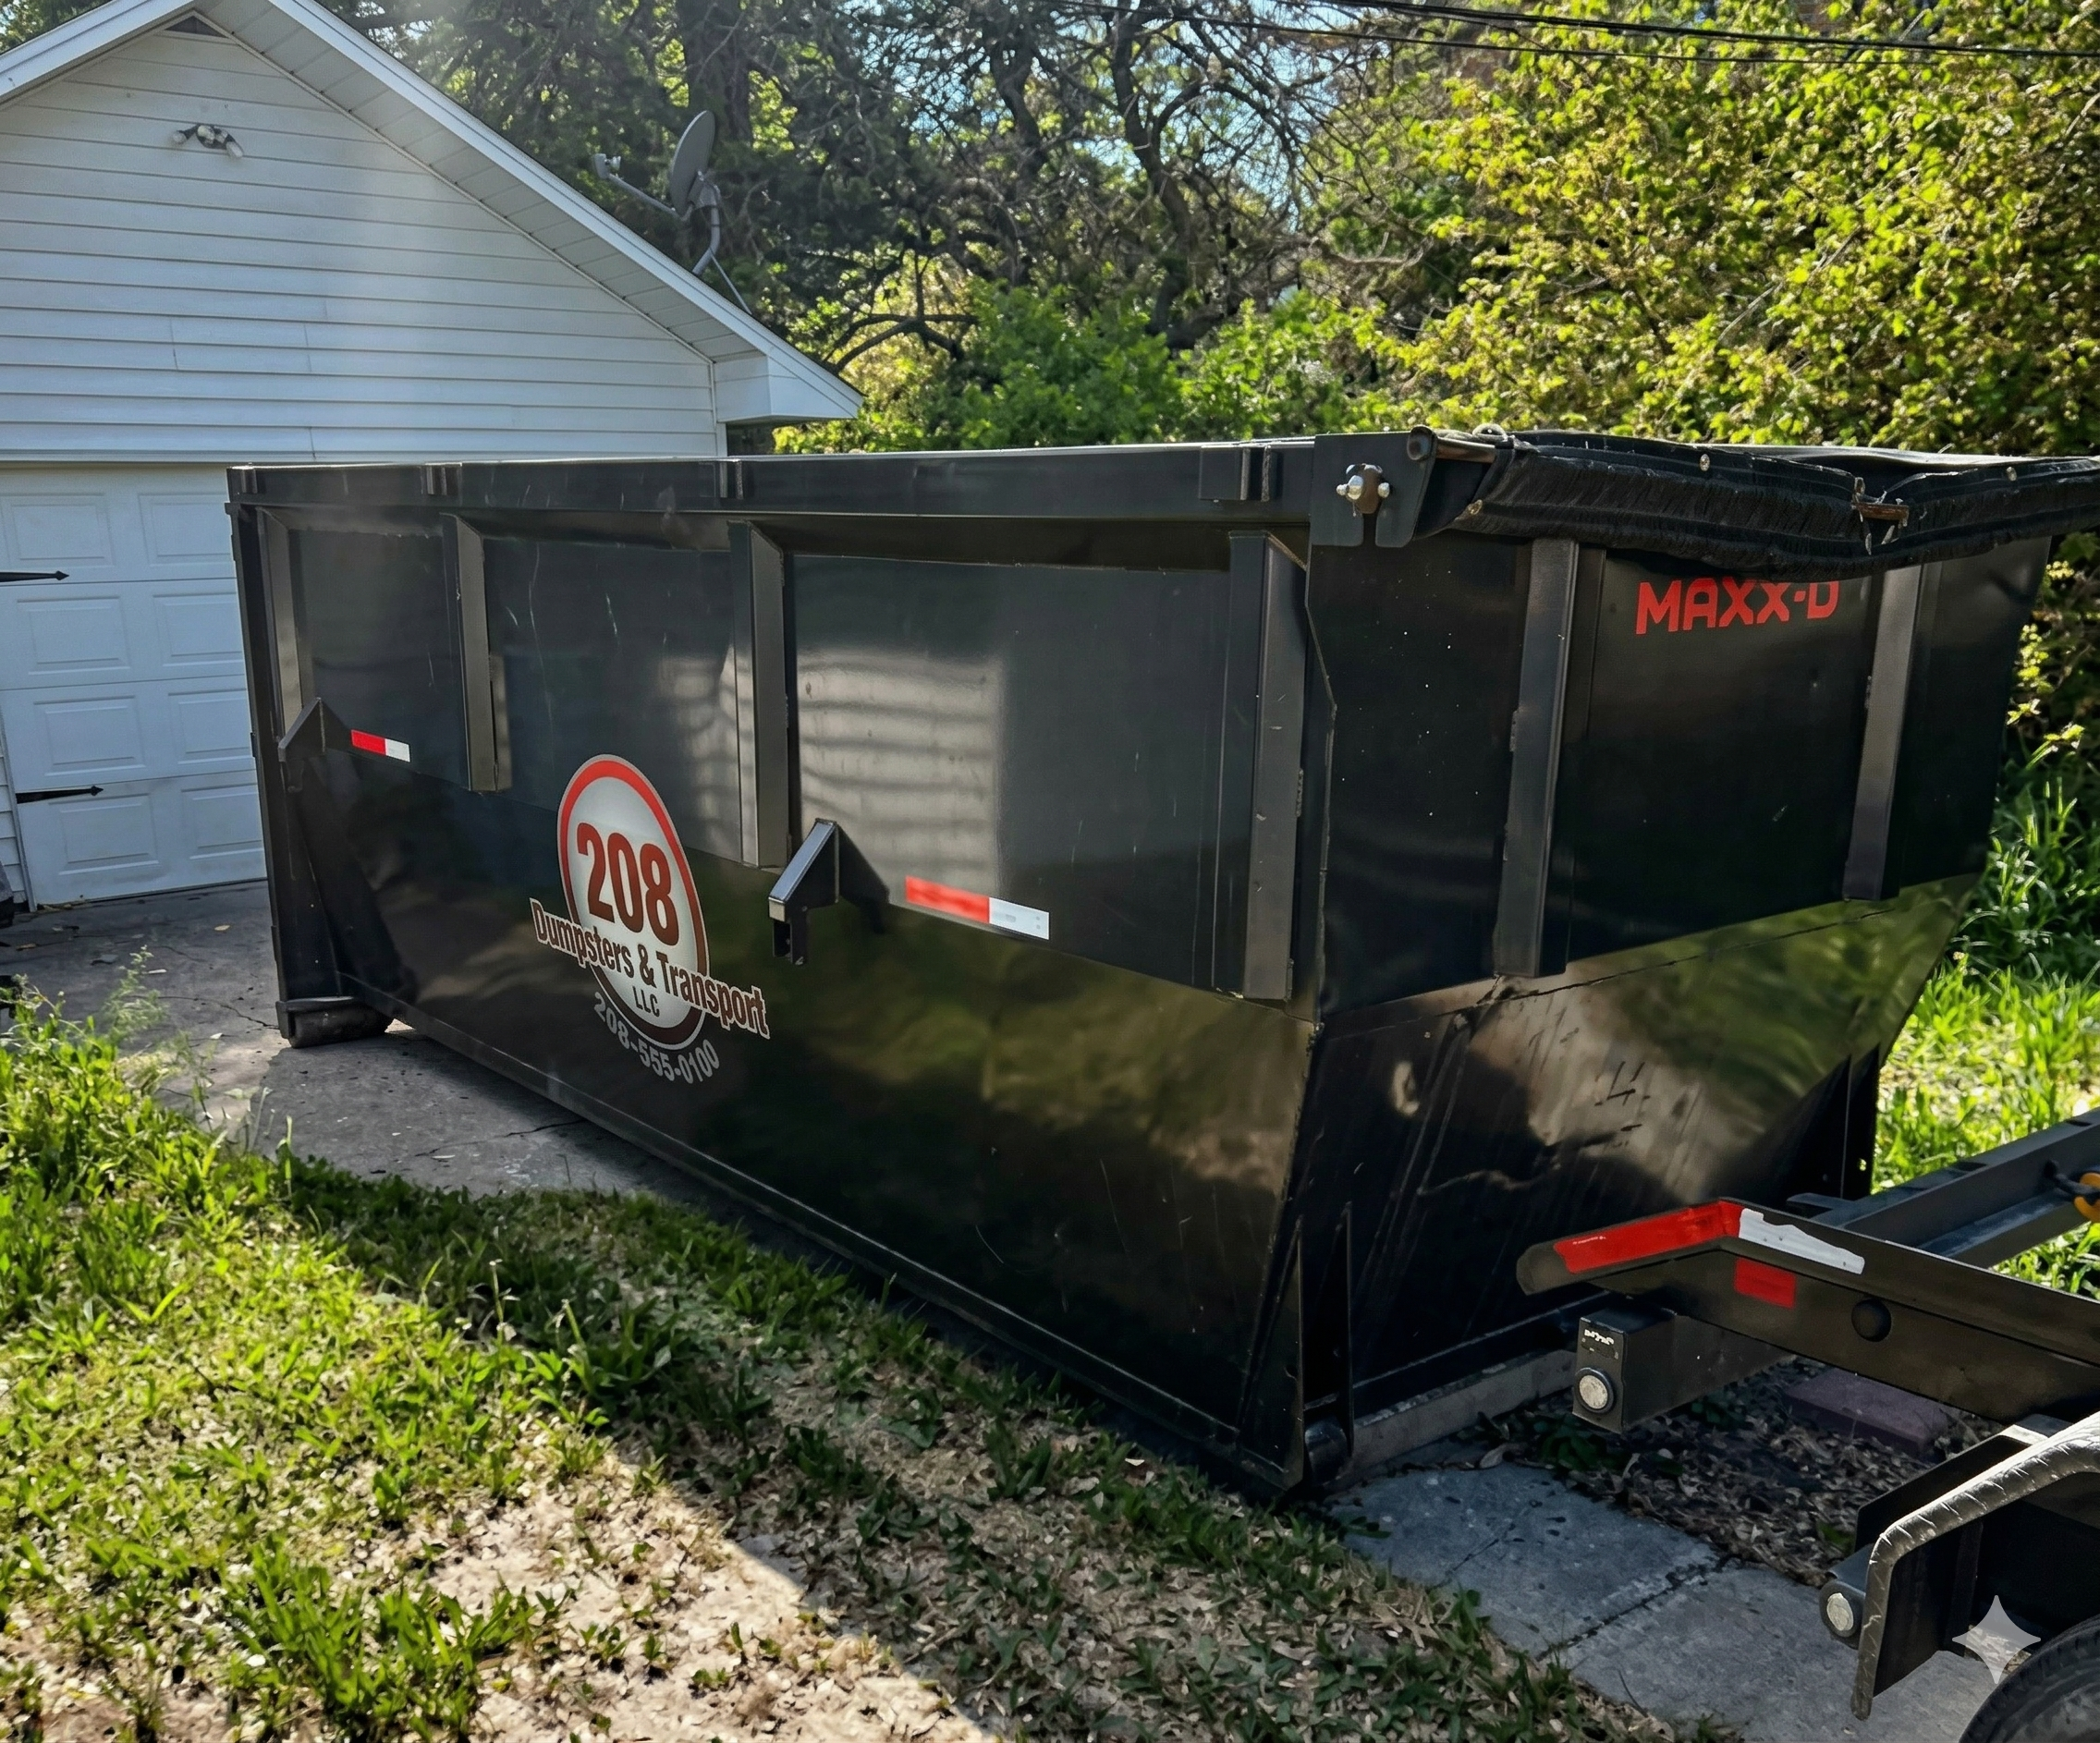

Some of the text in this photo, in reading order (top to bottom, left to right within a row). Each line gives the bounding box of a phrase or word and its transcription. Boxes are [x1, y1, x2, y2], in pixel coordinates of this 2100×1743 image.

[576, 822, 679, 946] 208
[531, 900, 769, 1038] Dumpsters & Transport
[632, 985, 661, 1018] LLC
[593, 991, 720, 1085] 208-555-0100
